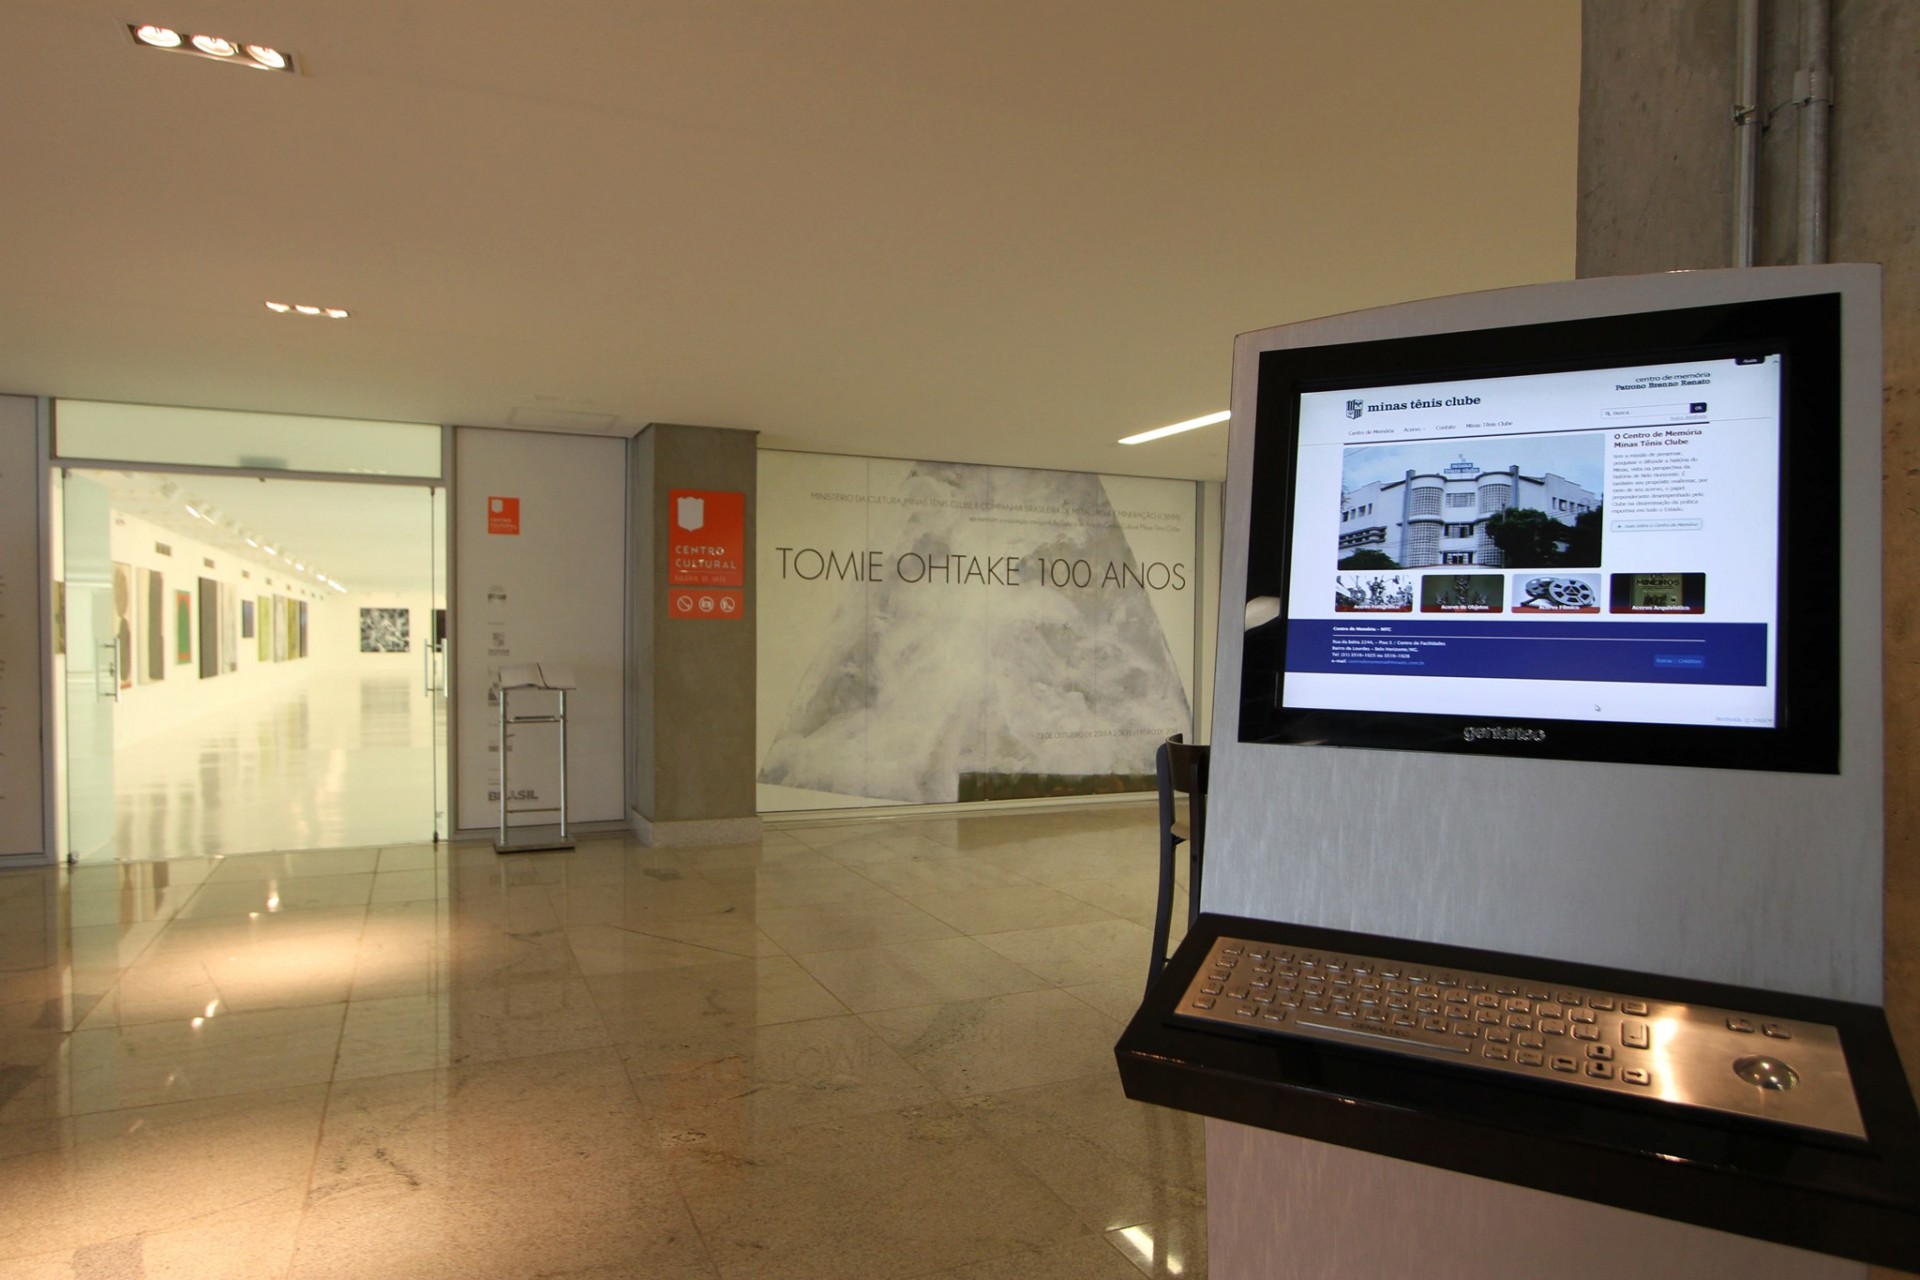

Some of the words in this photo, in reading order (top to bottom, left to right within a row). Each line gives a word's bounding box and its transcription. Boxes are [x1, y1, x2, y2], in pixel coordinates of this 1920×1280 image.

[1616, 382, 1646, 391] Patrono
[1649, 380, 1679, 389] Brenno
[1681, 378, 1711, 387] Renato
[1367, 402, 1408, 413] minas
[1410, 398, 1443, 410] tênis
[1445, 395, 1481, 407] clube
[1623, 432, 1650, 440] Centro
[1665, 429, 1703, 437] Memória
[1614, 441, 1638, 449] Minas
[1641, 440, 1663, 448] Tênis
[675, 545, 725, 556] CENTRO
[675, 558, 737, 569] CULTURAL
[776, 547, 883, 582] TOMIE
[897, 552, 1020, 586] OHTAKE
[1038, 558, 1091, 588] 100
[1101, 561, 1186, 591] ANOS
[488, 789, 539, 801] BASIL
[1352, 1022, 1409, 1037] GENIALTEC
